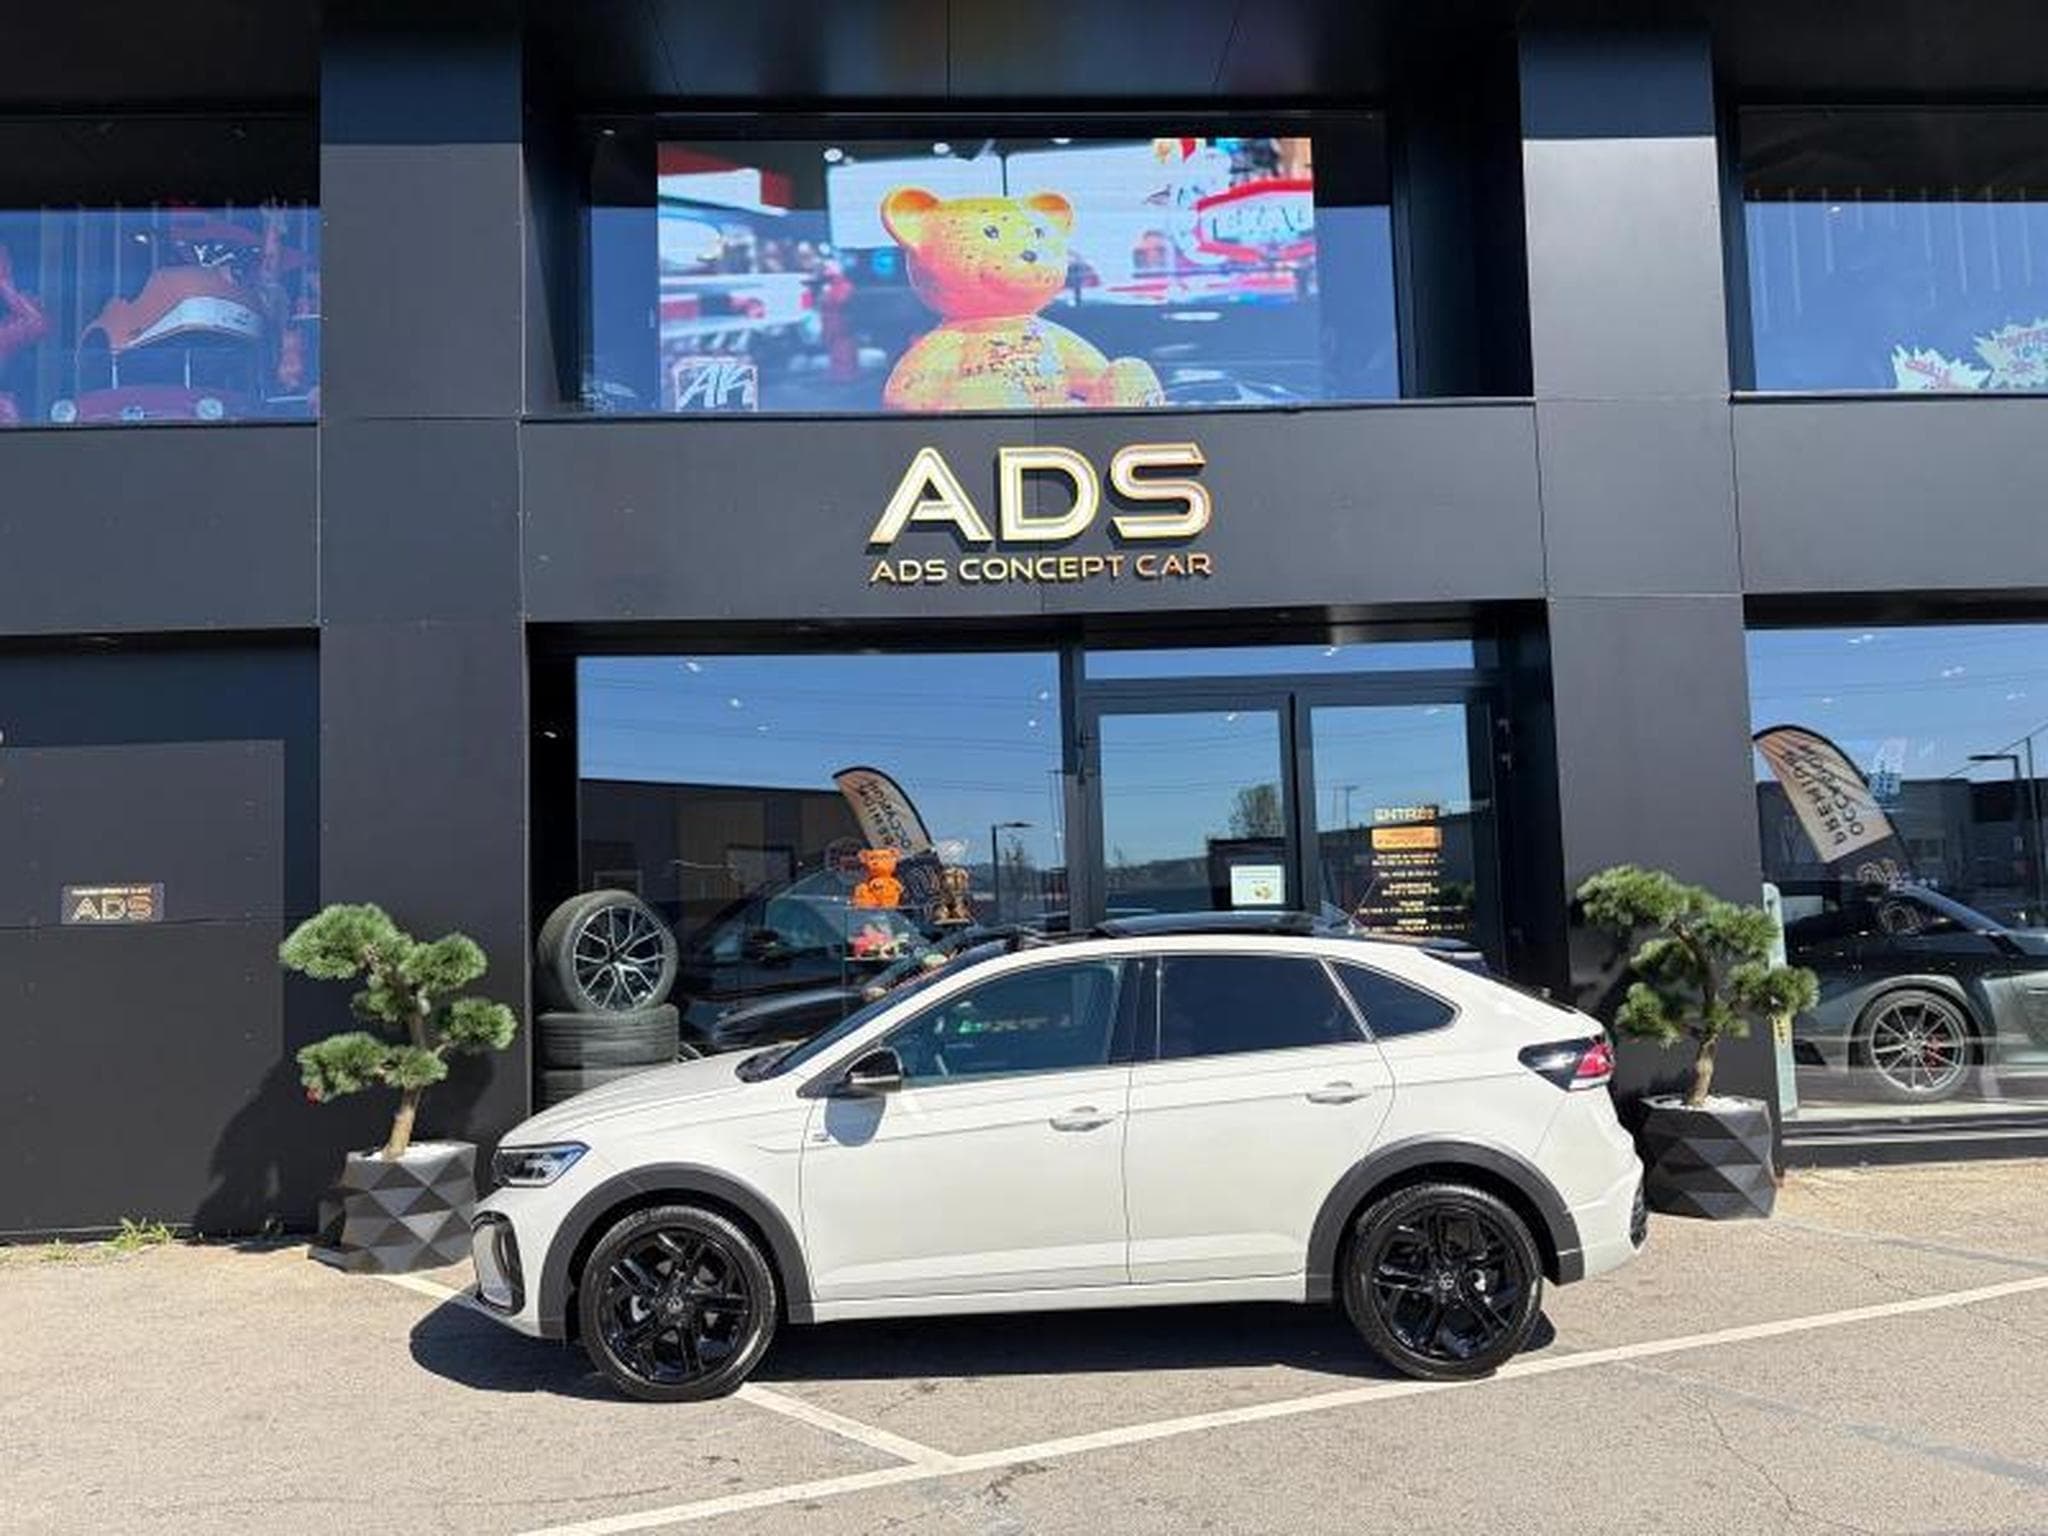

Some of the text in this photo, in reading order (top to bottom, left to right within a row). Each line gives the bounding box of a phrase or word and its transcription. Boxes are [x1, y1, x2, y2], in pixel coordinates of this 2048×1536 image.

[869, 443, 1213, 543] ADS
[869, 553, 1213, 583] ADS CONCEPT CAR
[71, 897, 153, 921] ADS
